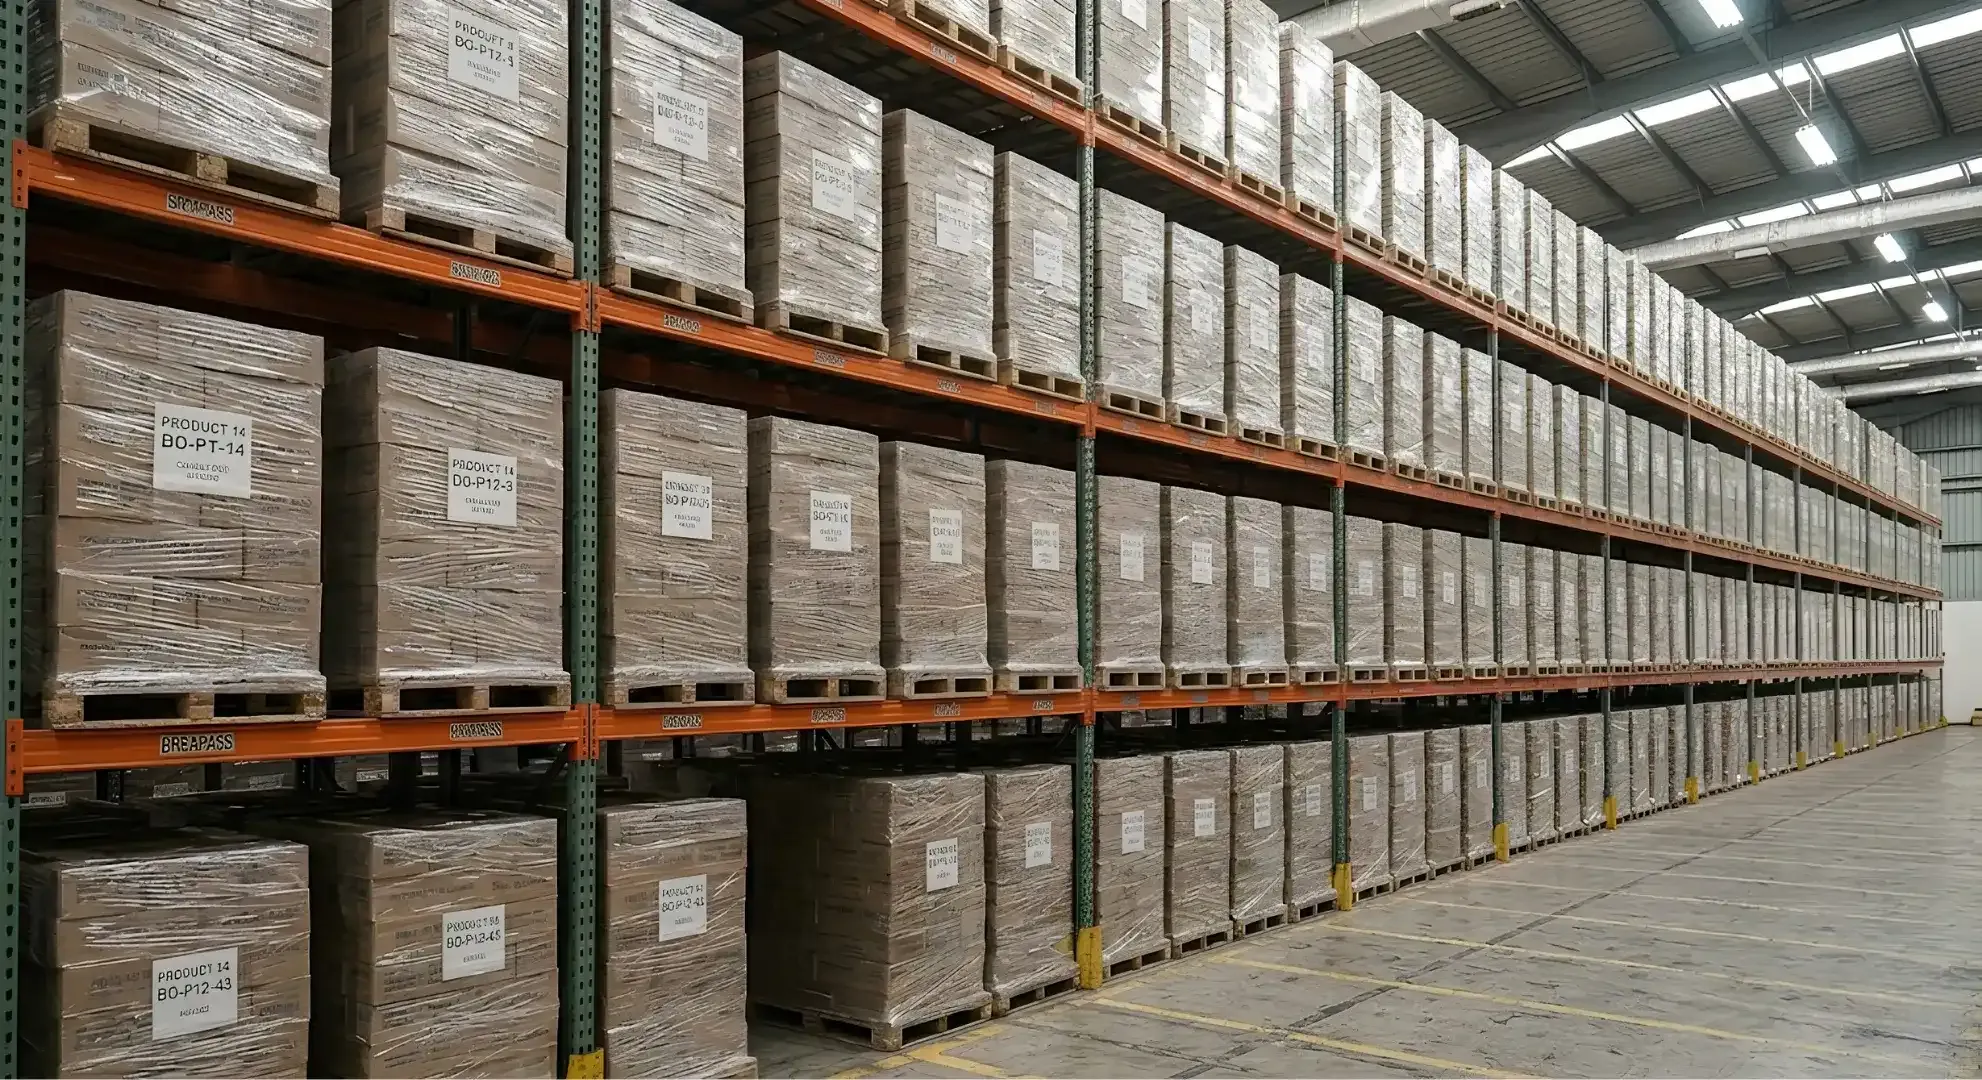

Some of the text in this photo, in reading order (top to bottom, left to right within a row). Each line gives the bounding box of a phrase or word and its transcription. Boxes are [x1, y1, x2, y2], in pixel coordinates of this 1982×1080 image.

[161, 416, 245, 437] PRODUCT 14
[161, 433, 245, 457] BO-PT-14
[161, 734, 233, 753] BREAPASS
[157, 977, 232, 1002] BO-P12-43
